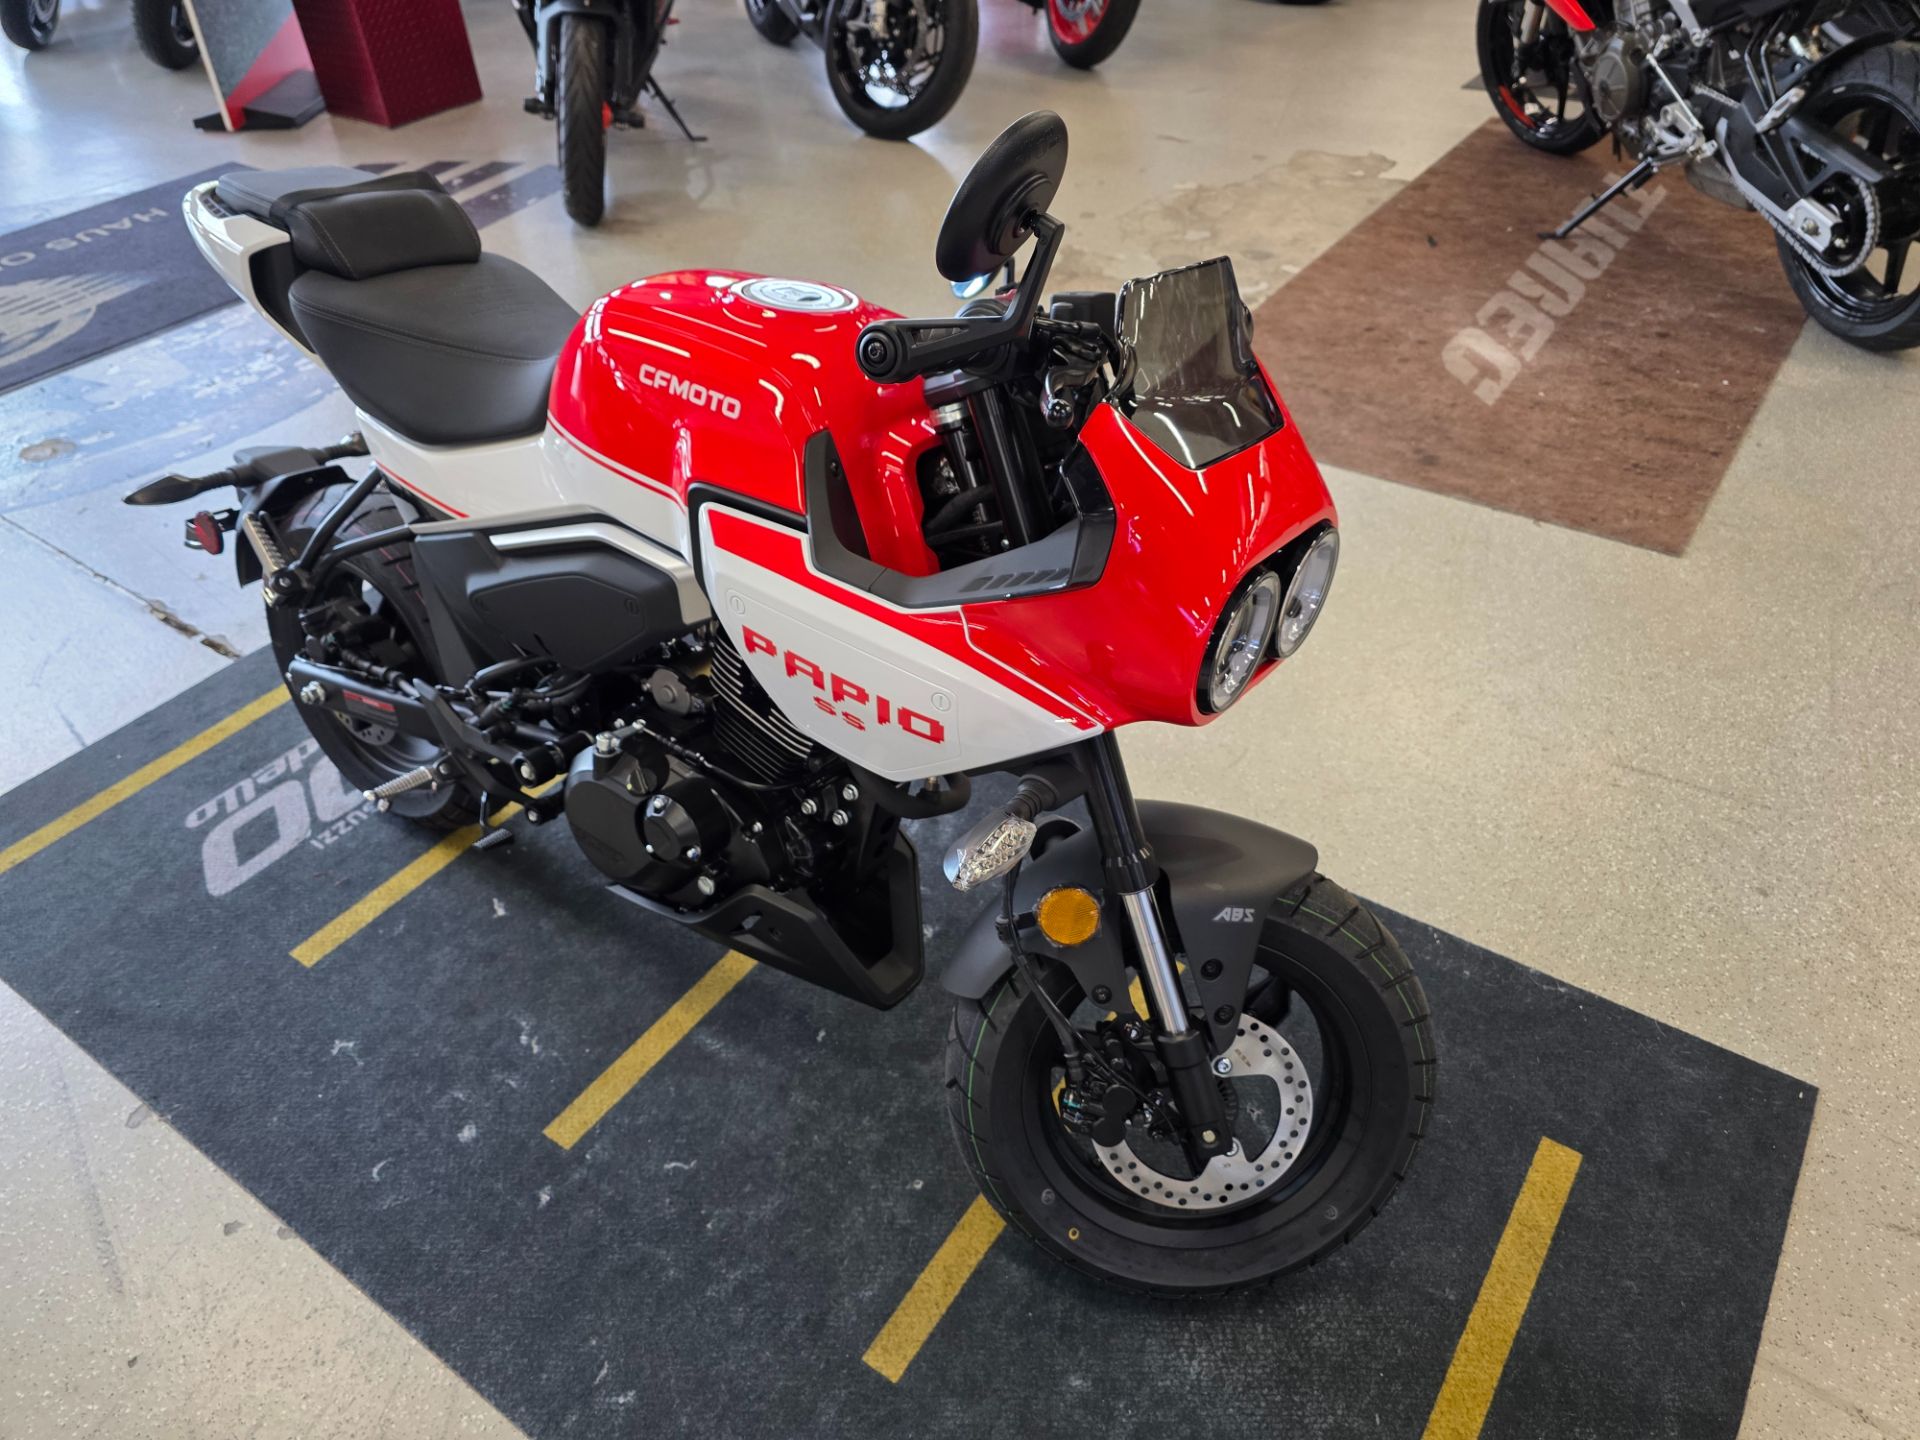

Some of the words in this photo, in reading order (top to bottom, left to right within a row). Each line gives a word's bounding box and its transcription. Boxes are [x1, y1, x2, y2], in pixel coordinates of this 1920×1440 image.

[45, 207, 169, 250] HAUS
[639, 363, 742, 420] CFMOTO
[742, 624, 945, 744] PAPIO
[813, 696, 866, 731] SS
[1212, 906, 1256, 922] ABS
